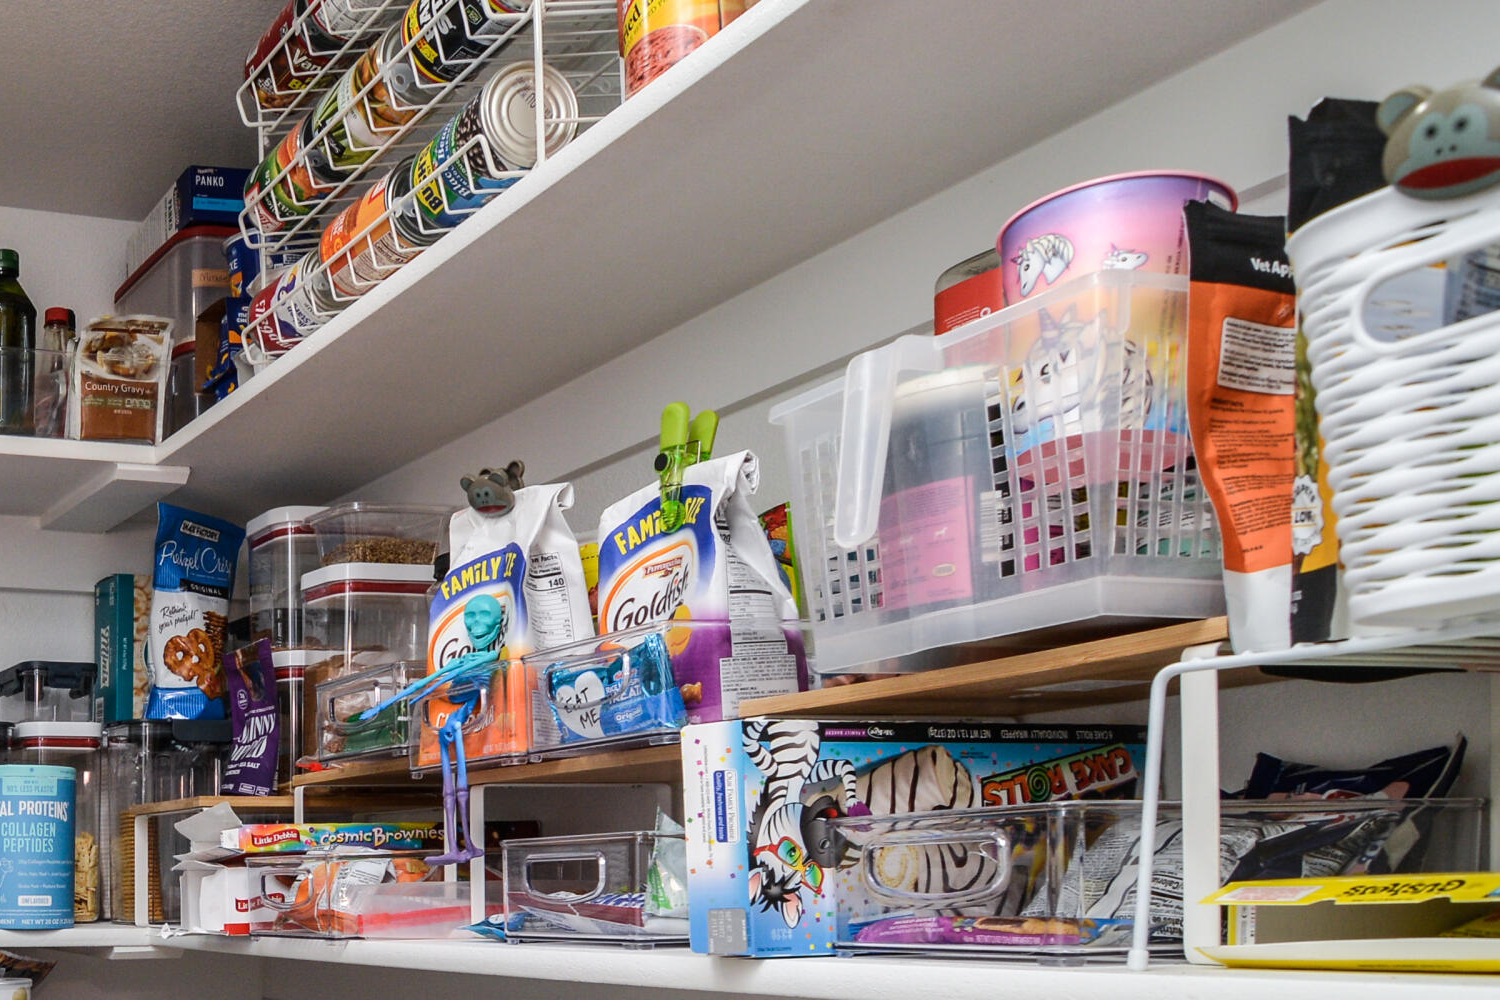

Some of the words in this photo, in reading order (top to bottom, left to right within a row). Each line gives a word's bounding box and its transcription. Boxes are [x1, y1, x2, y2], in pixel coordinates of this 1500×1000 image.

[195, 174, 224, 187] PANKO
[84, 381, 120, 393] Country
[120, 383, 145, 395] Gravy
[160, 540, 199, 576] Pretzel
[440, 556, 502, 600] FAMILY
[548, 578, 565, 588] 140
[613, 563, 690, 632] Goldfish
[579, 708, 600, 730] ME
[1070, 748, 1132, 792] CAKE
[982, 763, 1069, 808] ROLLS
[18, 800, 68, 822] PROTEINS
[0, 822, 56, 837] COLLAGEN
[253, 834, 274, 846] Little
[372, 826, 445, 846] Brownies
[3, 837, 54, 853] PEPTIDES
